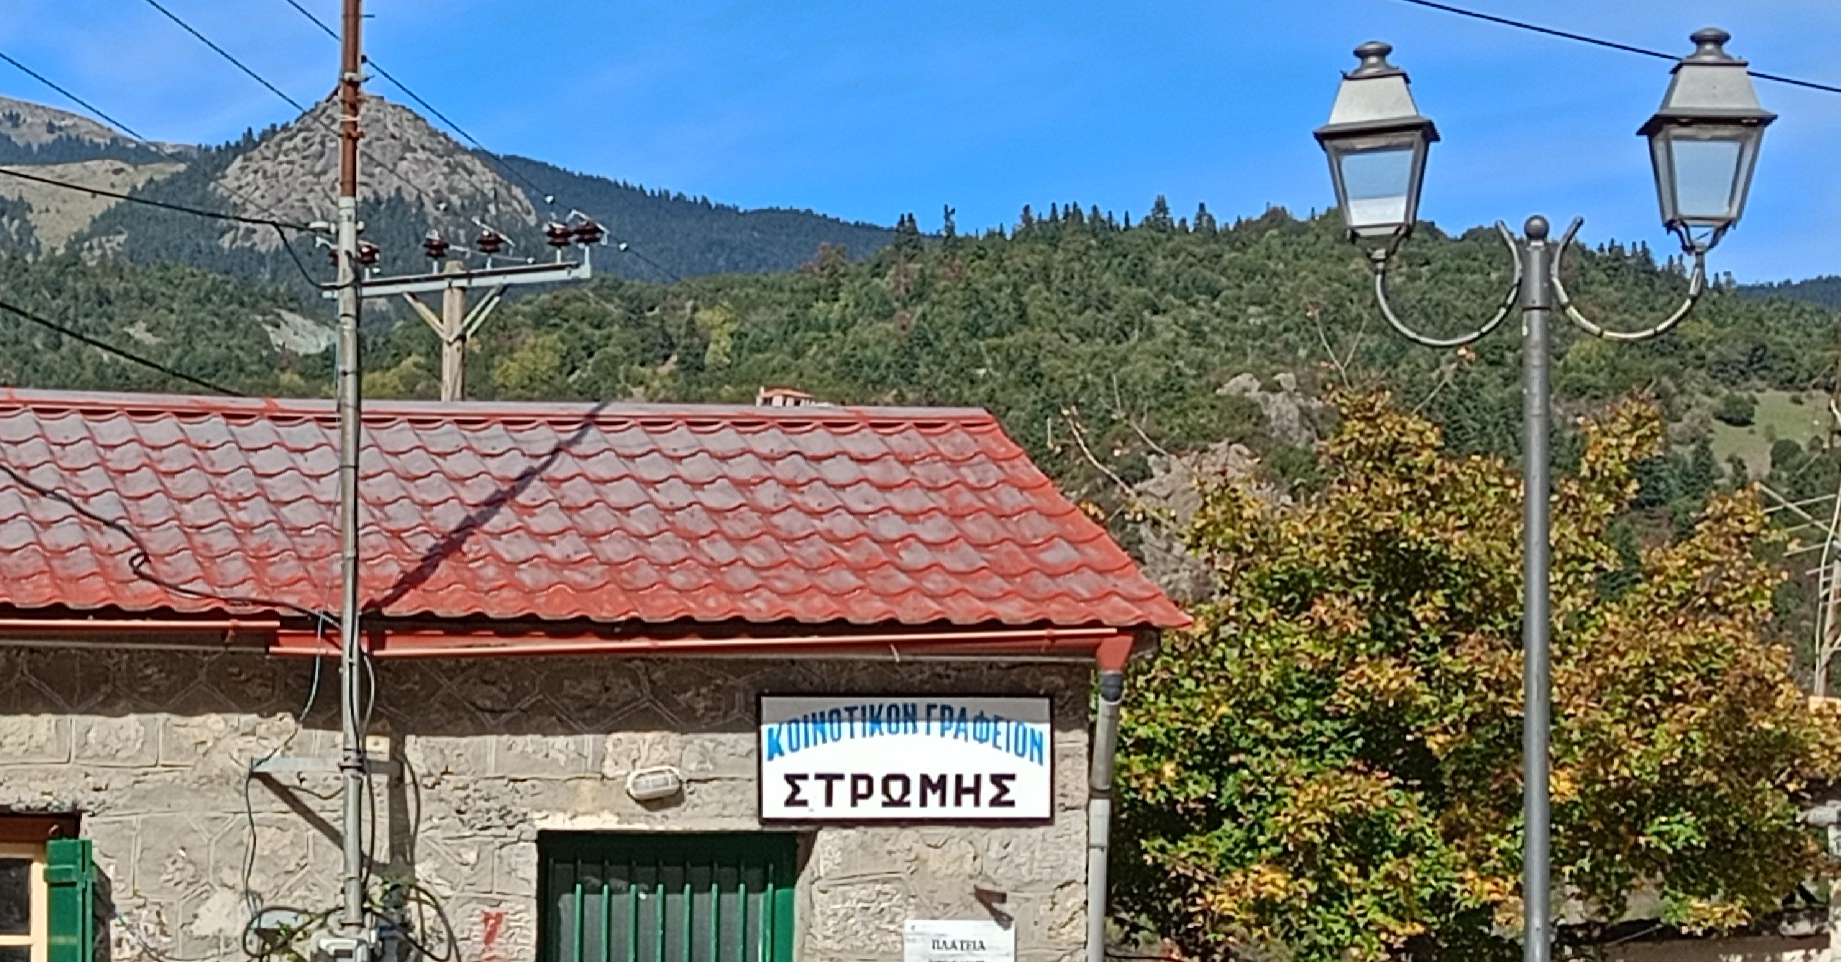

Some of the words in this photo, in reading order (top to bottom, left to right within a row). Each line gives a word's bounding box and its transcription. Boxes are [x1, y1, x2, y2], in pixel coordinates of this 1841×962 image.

[766, 702, 918, 762] ΚΟΙΝΟΤΙΚΟΝ
[925, 703, 1044, 767] ΓΡΑΦΕΙΟΝ
[783, 772, 1017, 808] ΣΤΡΩΜΗΣ
